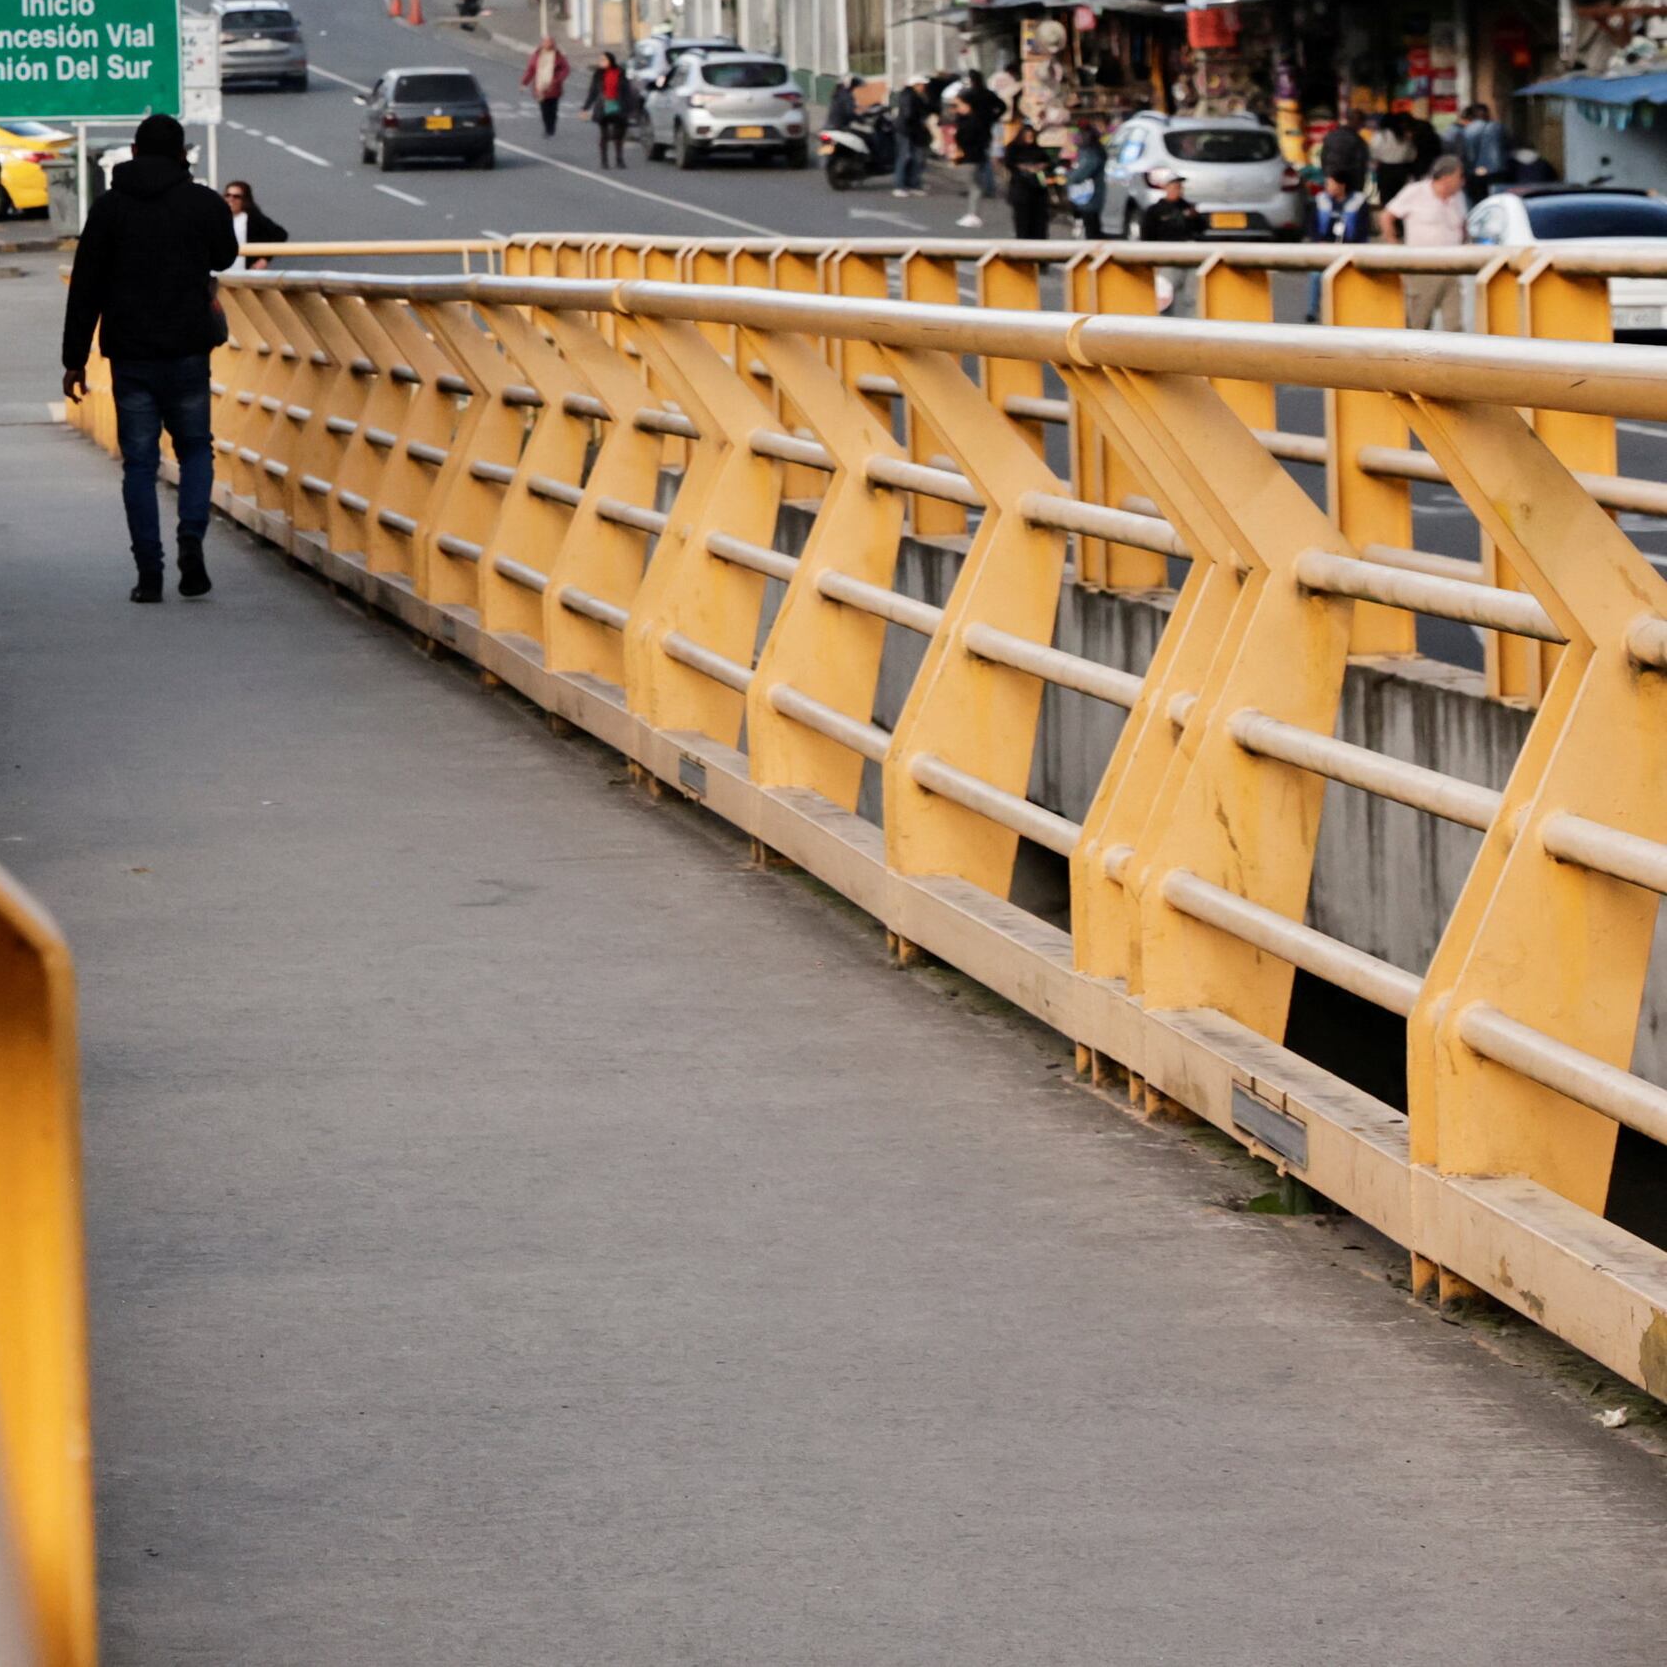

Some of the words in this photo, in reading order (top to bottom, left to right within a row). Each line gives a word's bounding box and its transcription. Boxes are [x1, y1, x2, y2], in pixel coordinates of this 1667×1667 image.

[105, 23, 155, 48] Vial
[56, 55, 98, 80] Del
[107, 55, 153, 80] Sur
